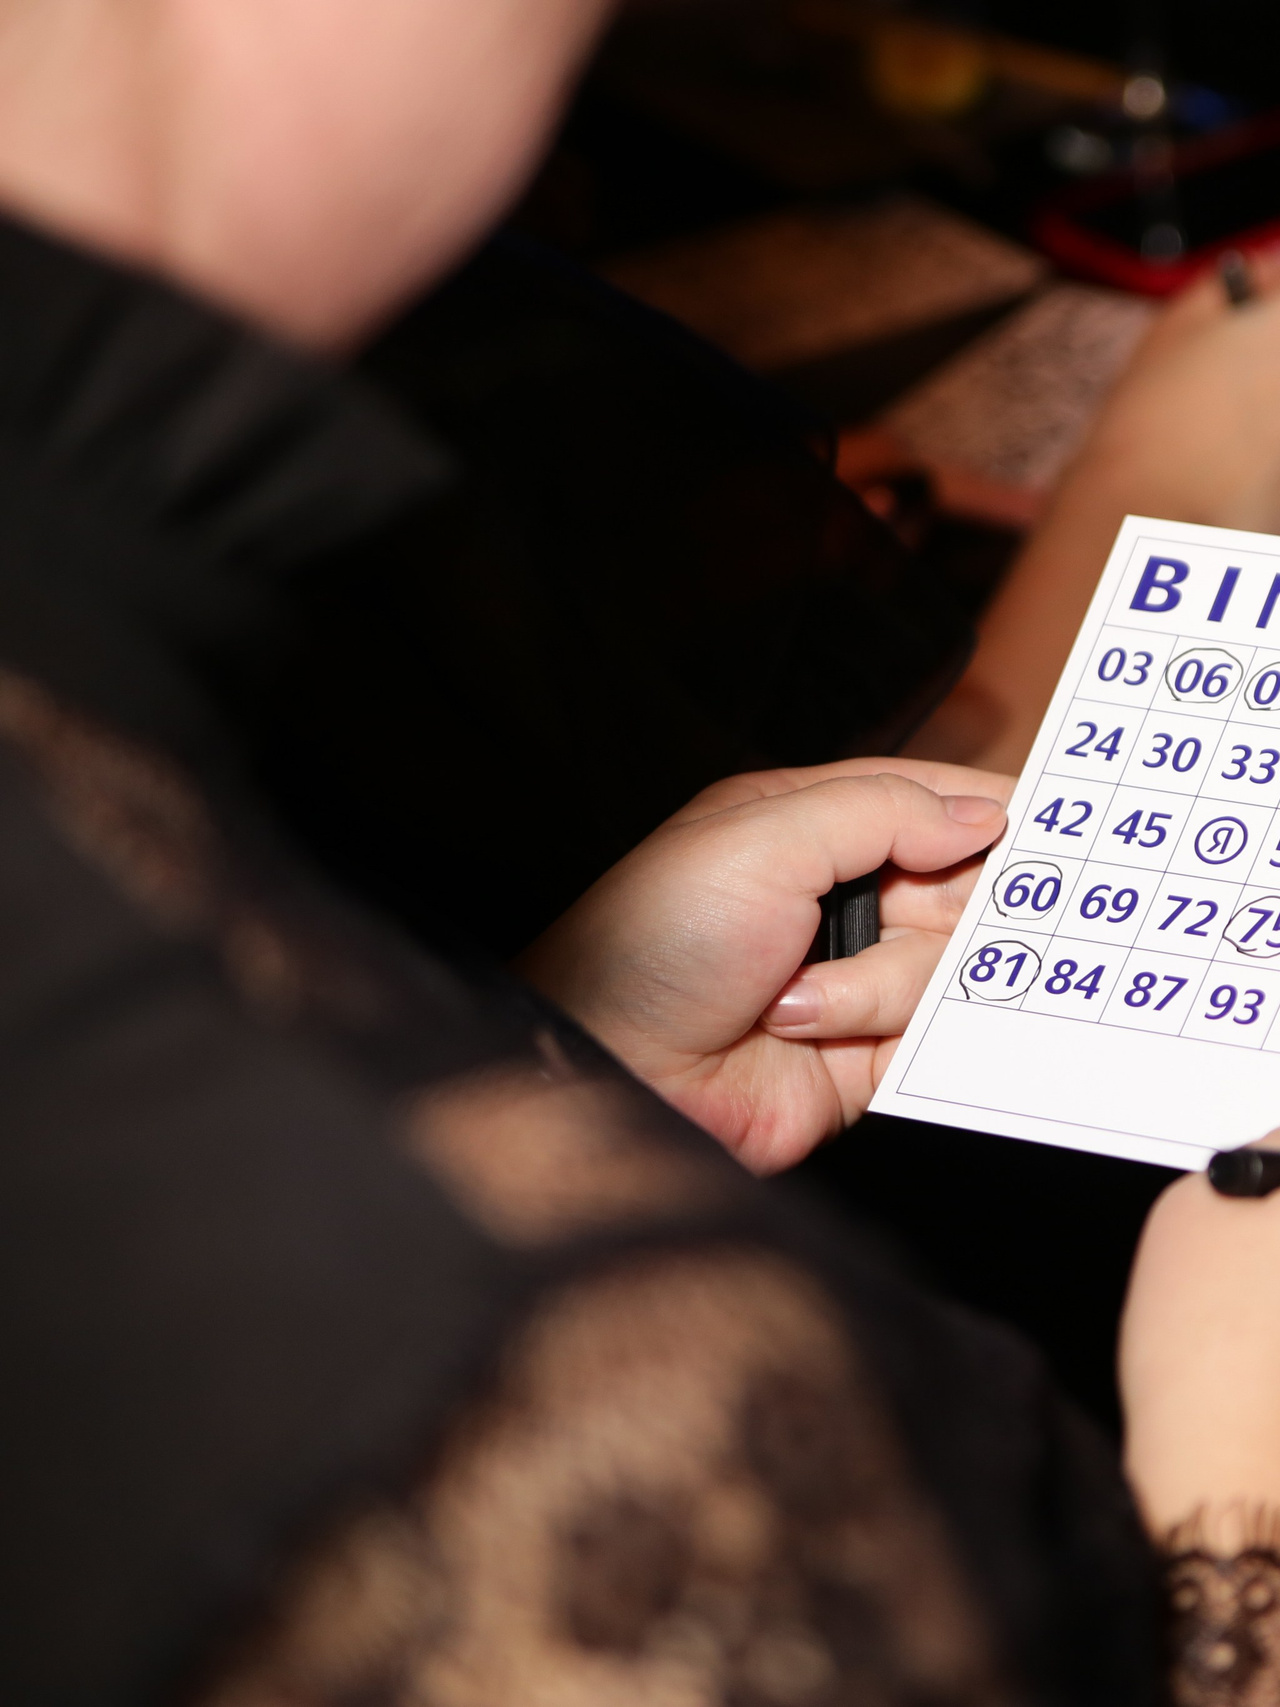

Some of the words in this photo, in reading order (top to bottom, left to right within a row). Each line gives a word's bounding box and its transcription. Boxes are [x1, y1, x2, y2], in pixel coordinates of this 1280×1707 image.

[1097, 647, 1152, 684] 03
[1174, 659, 1231, 696] 06
[1064, 721, 1122, 760] 24
[1141, 732, 1201, 772] 30
[1220, 744, 1280, 783] 33
[1033, 797, 1092, 836] 42
[1112, 809, 1171, 847] 45
[1003, 872, 1060, 911] 60
[1080, 884, 1138, 922] 69
[1157, 894, 1218, 936] 72
[969, 947, 1027, 986] 81
[1045, 958, 1104, 999] 84
[1124, 971, 1188, 1010] 87
[1203, 984, 1265, 1024] 93
